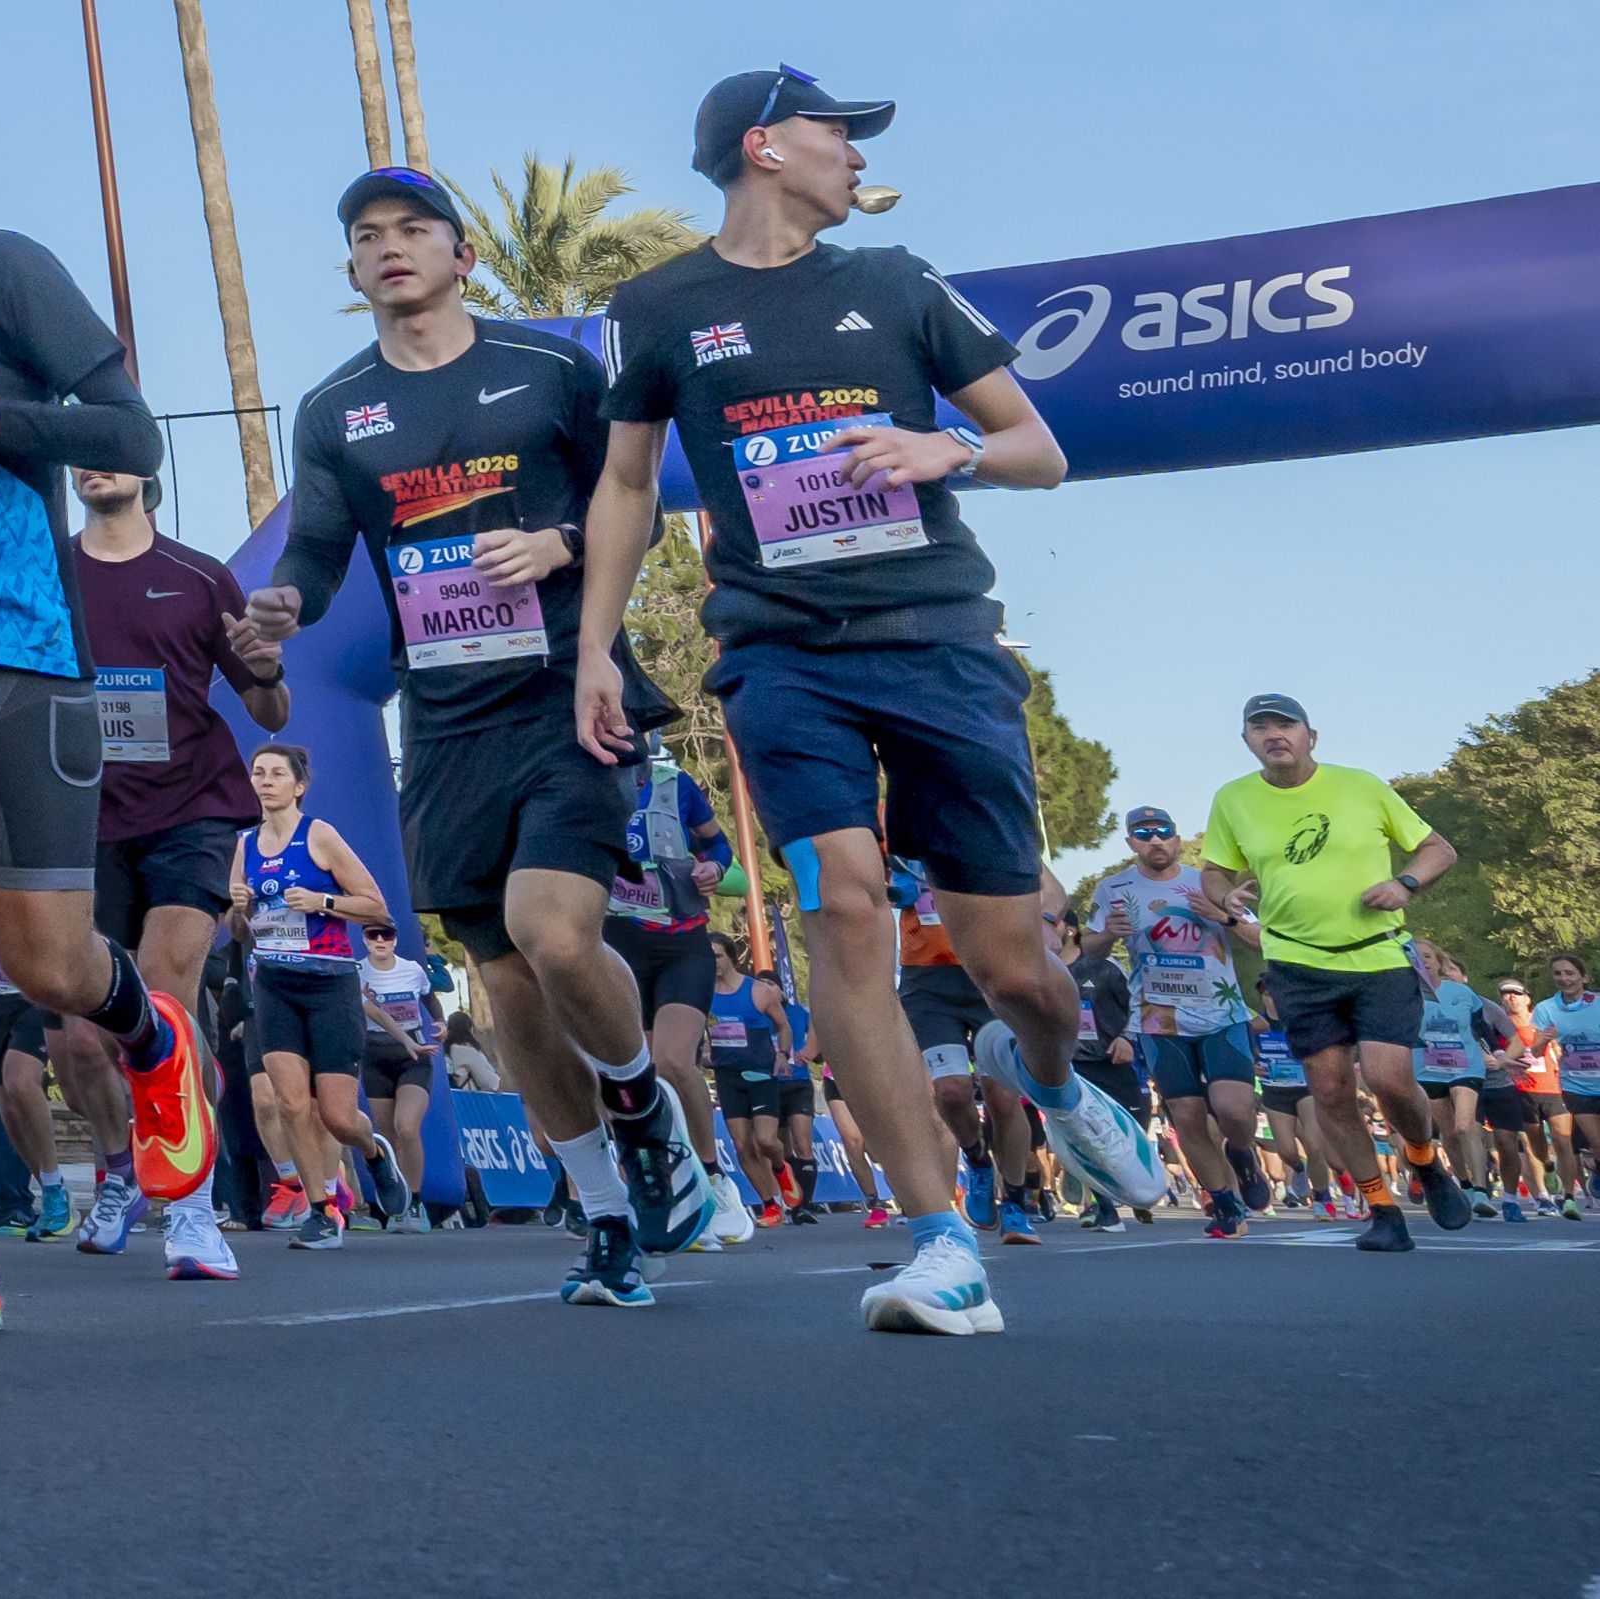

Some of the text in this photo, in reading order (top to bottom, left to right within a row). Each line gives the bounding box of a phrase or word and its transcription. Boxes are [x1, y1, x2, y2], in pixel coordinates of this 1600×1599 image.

[1121, 265, 1354, 351] asics
[696, 343, 752, 367] JUSTIN
[1119, 341, 1428, 399] sound mind, sound body
[723, 388, 879, 423] SEVILLA 2026
[740, 403, 863, 435] MARATHON
[345, 421, 395, 443] MARCO
[380, 454, 519, 491] SEVILLA 2026
[395, 472, 502, 503] MARATHON
[785, 493, 889, 532] JUSTIN
[440, 581, 480, 600] 9940
[422, 603, 515, 637] MARCO
[95, 674, 152, 686] ZURICH
[613, 883, 659, 907] SOPHIE
[1160, 957, 1197, 967] ZURICH
[1151, 982, 1198, 995] PUMUKI
